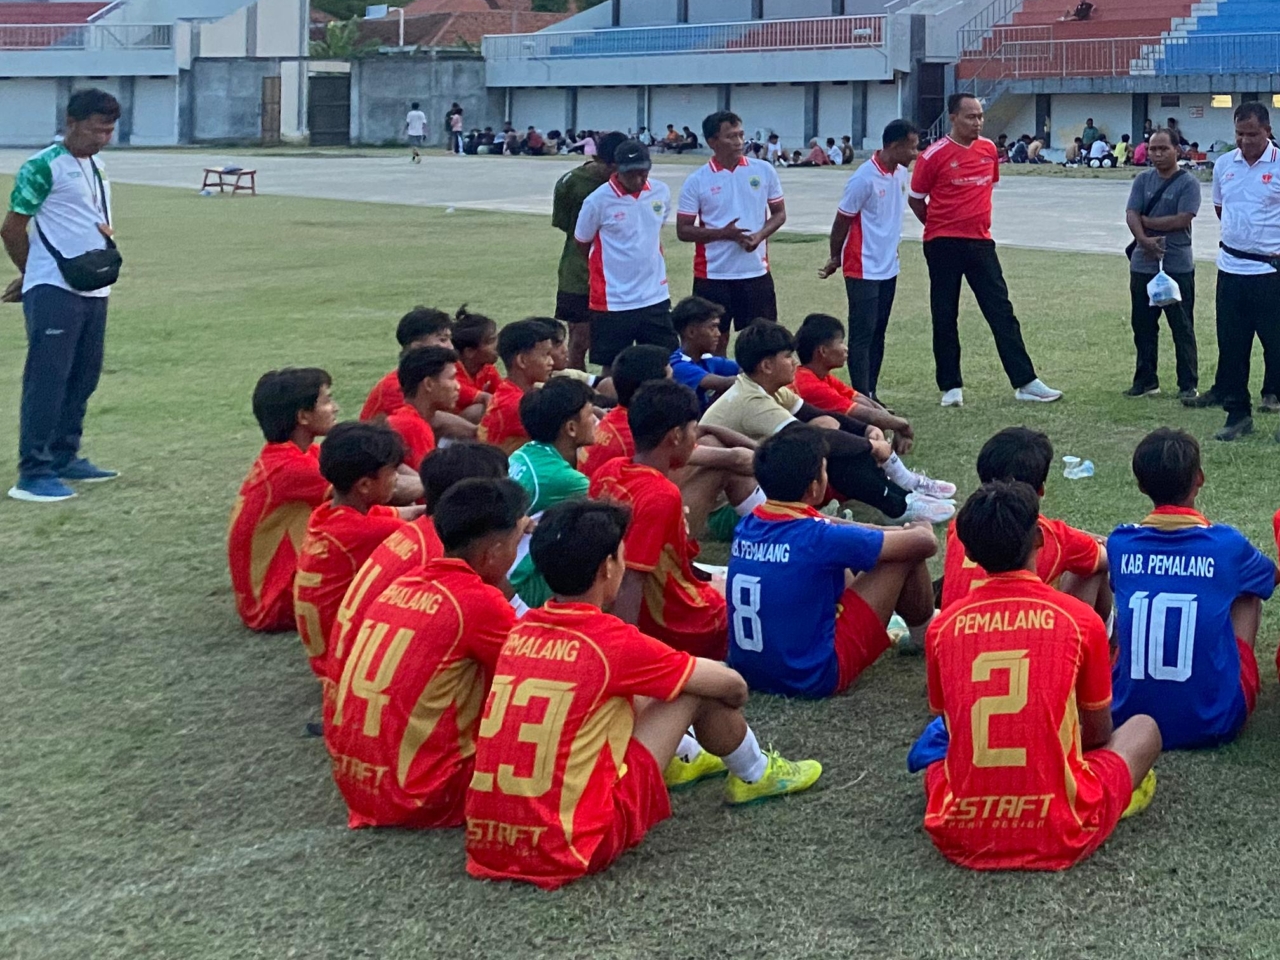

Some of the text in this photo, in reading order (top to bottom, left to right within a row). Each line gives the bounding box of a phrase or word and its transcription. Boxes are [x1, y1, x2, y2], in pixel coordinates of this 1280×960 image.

[740, 540, 790, 563] PEMALANG
[1120, 554, 1215, 578] KAB. PEMALANG
[731, 573, 763, 653] 8
[954, 609, 1055, 637] PEMALANG
[1128, 591, 1198, 682] 10
[333, 619, 416, 738] 14
[971, 649, 1030, 768] 2
[466, 817, 549, 848] STAFT
